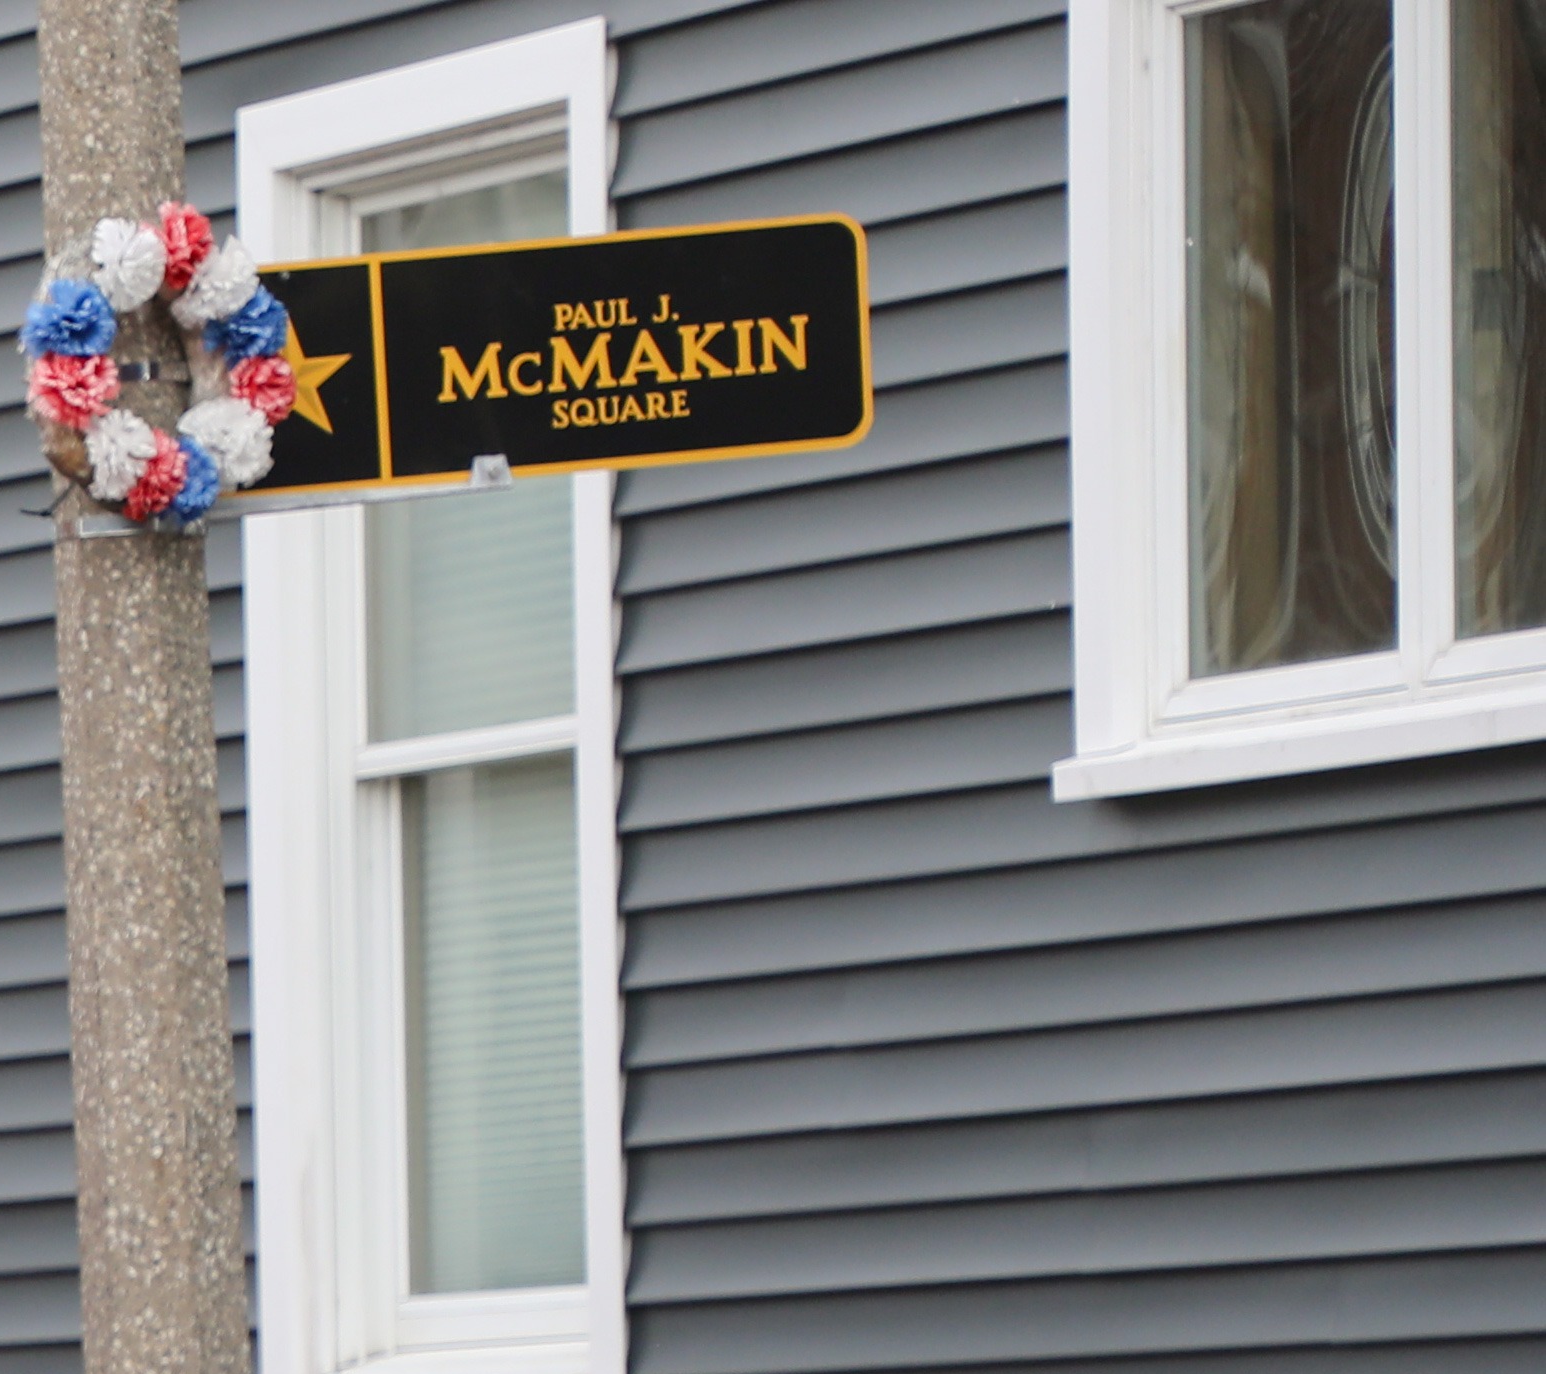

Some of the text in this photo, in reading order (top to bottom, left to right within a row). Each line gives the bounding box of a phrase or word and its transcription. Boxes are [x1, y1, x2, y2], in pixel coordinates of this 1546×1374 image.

[553, 294, 680, 331] PAUL J.
[438, 314, 809, 403] McMAKIN
[552, 389, 691, 430] SQUARE
